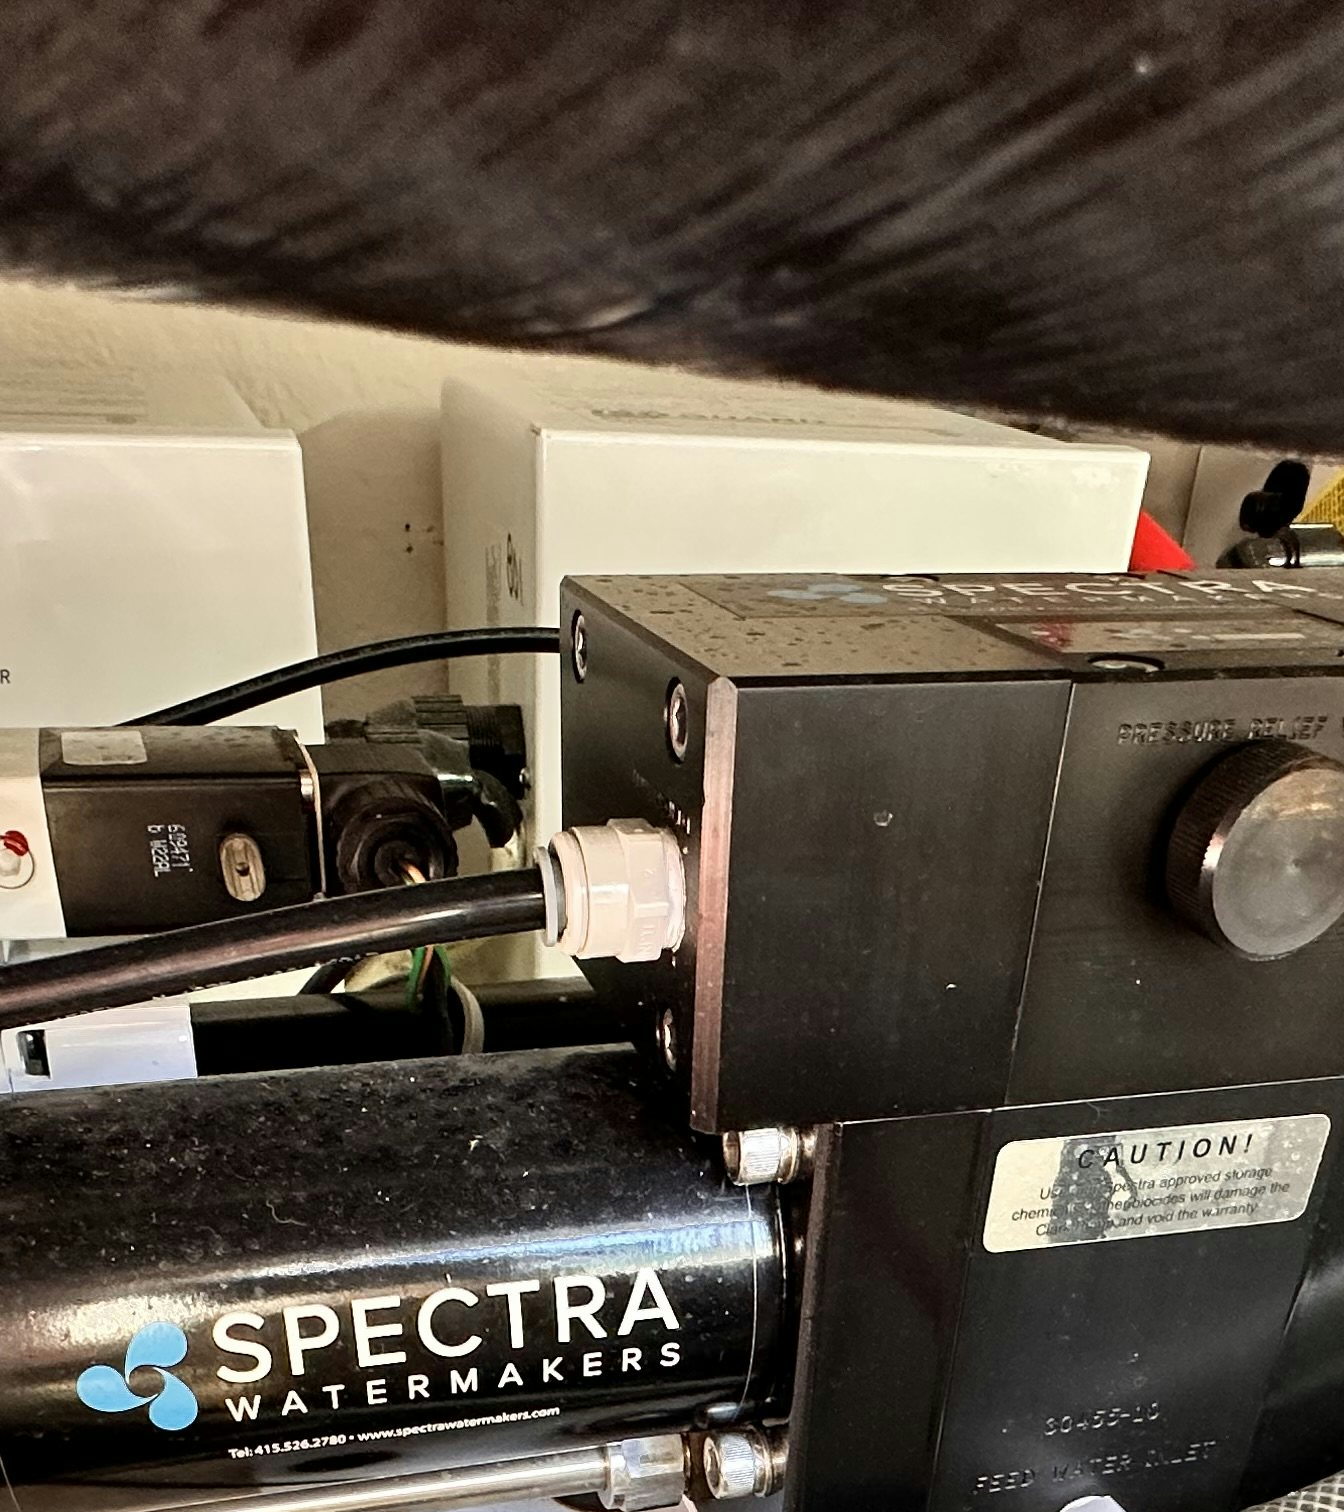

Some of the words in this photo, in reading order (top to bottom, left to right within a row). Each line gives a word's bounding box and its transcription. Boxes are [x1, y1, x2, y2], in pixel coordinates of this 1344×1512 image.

[881, 579, 1317, 598] SPECTRA
[1118, 718, 1236, 745] PRESSURE
[1077, 1133, 1254, 1170] CAUTION!
[1159, 1171, 1221, 1191] approved
[1224, 1167, 1273, 1184] storage
[1213, 1185, 1266, 1203] damage
[1269, 1181, 1290, 1195] the
[1177, 1206, 1199, 1221] the
[212, 1266, 681, 1384] SPECTRA
[225, 1342, 682, 1423] WATERMAKERS
[357, 1405, 561, 1442] www.spectrawatermakers.com
